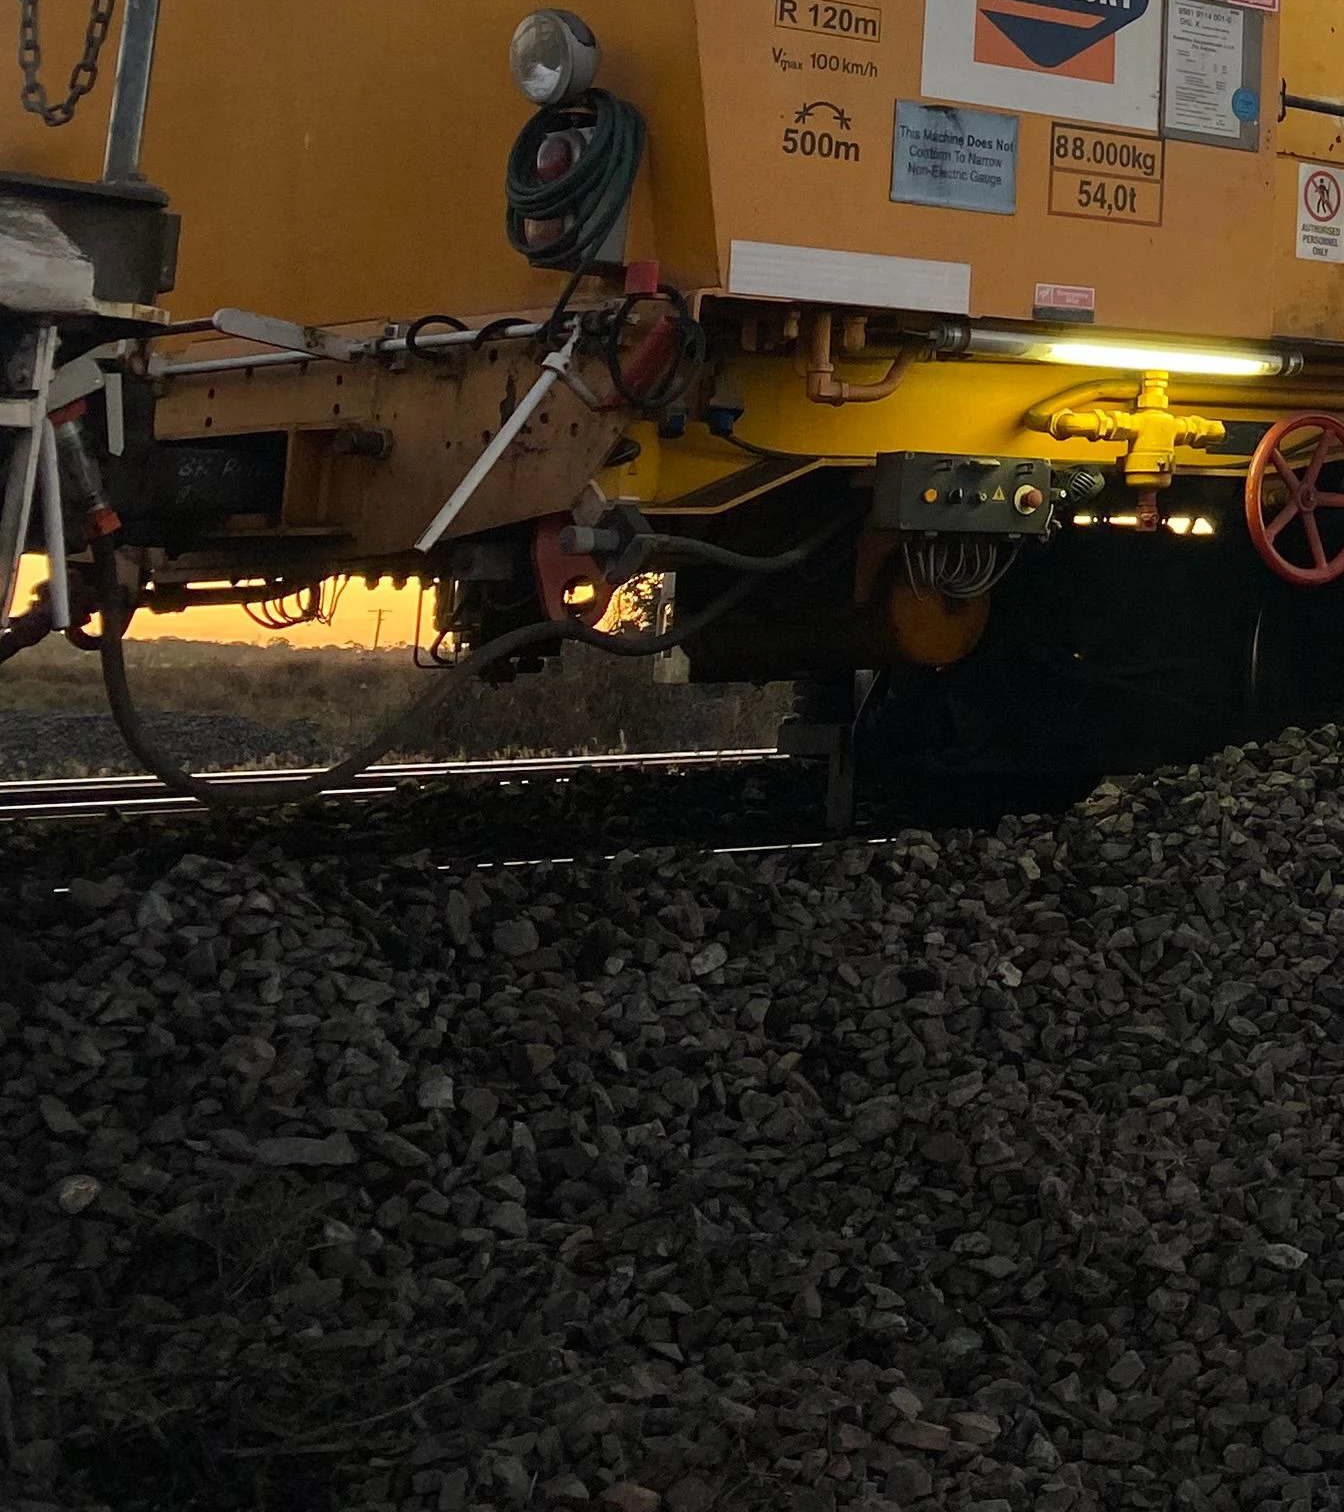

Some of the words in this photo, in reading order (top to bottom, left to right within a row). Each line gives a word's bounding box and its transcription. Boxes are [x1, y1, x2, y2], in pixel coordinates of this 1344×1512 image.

[808, 3, 877, 37] 120m
[809, 52, 840, 72] 100
[842, 57, 878, 78] km/h
[782, 127, 860, 162] 500m
[900, 124, 921, 140] This
[923, 128, 965, 148] Machine
[967, 134, 993, 150] Does
[996, 138, 1015, 153] Not
[954, 150, 966, 164] To
[968, 152, 1003, 169] Narrow
[1055, 134, 1156, 176] 88.000kg
[969, 170, 1002, 188] Gauge
